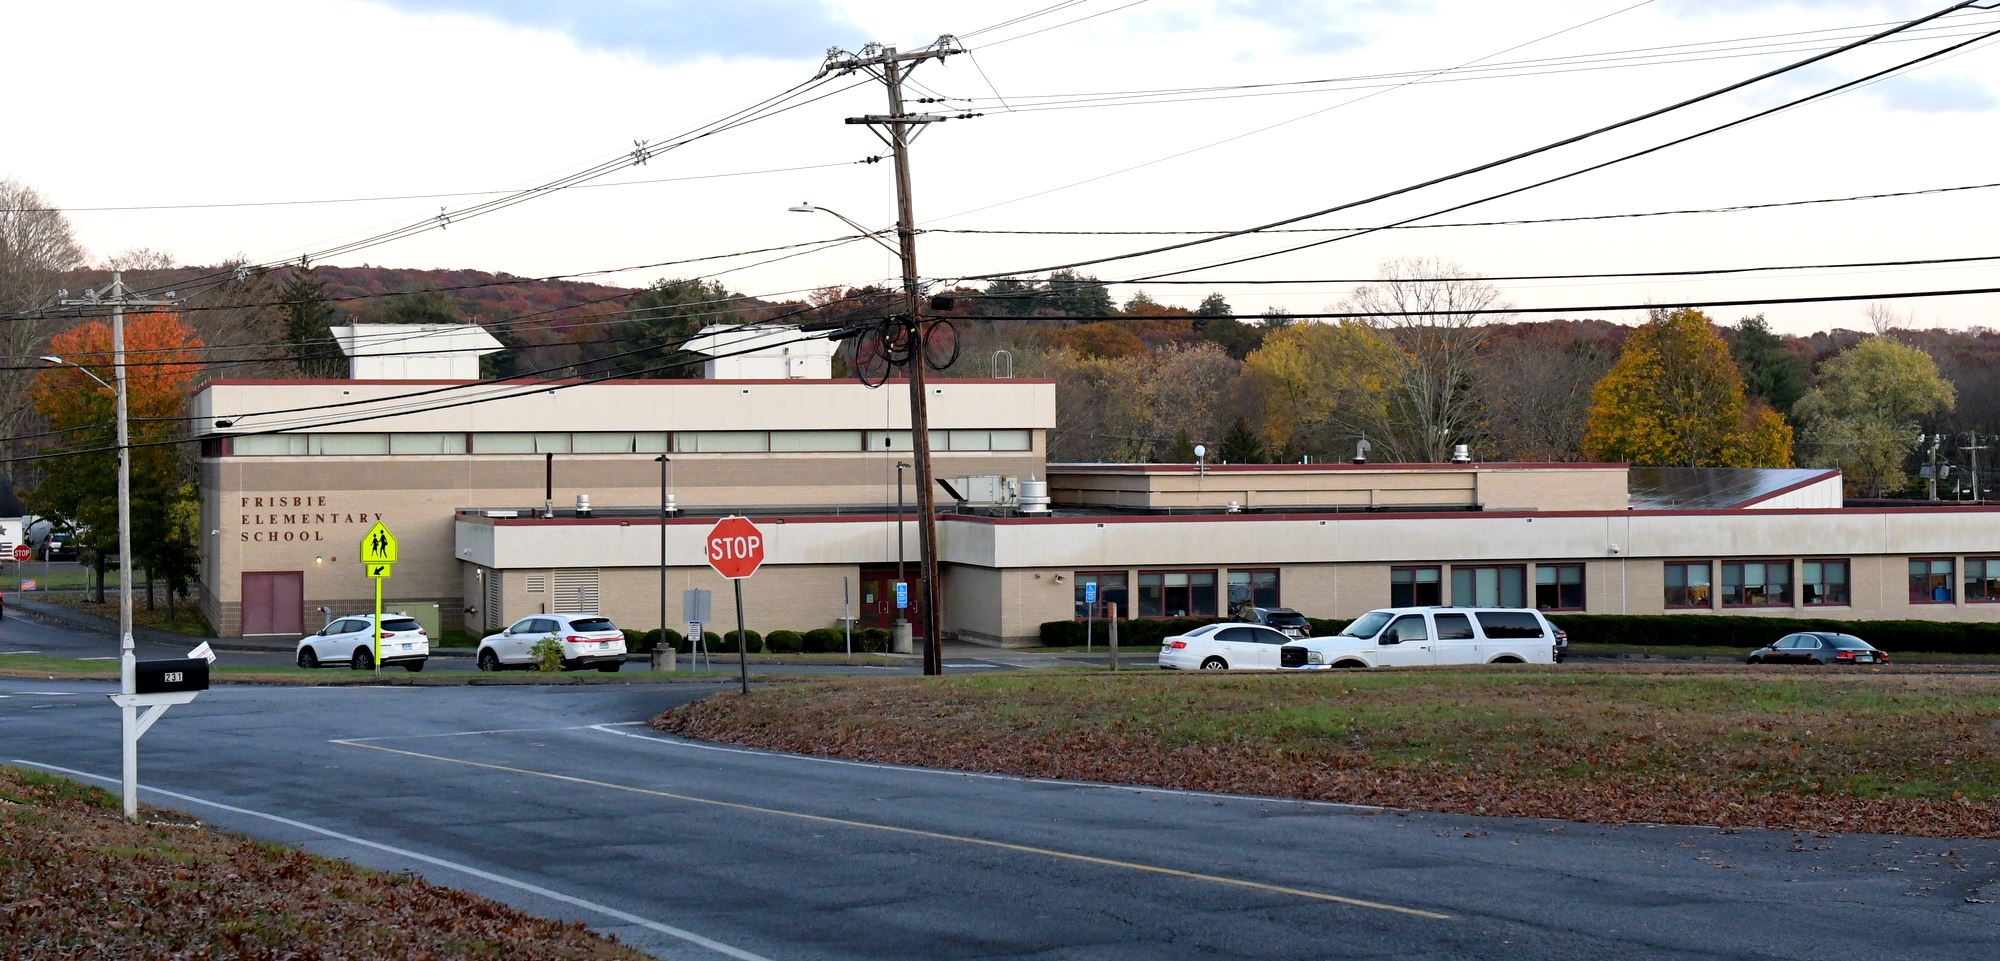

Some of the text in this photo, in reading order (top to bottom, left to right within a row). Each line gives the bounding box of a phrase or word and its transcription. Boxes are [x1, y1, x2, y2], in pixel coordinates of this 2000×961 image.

[241, 496, 326, 507] FRISBIE
[241, 513, 383, 525] ELEMENTARY
[240, 531, 324, 542] SCHOOL
[14, 549, 30, 557] STOP
[711, 535, 760, 561] STOP
[165, 673, 182, 682] 231
